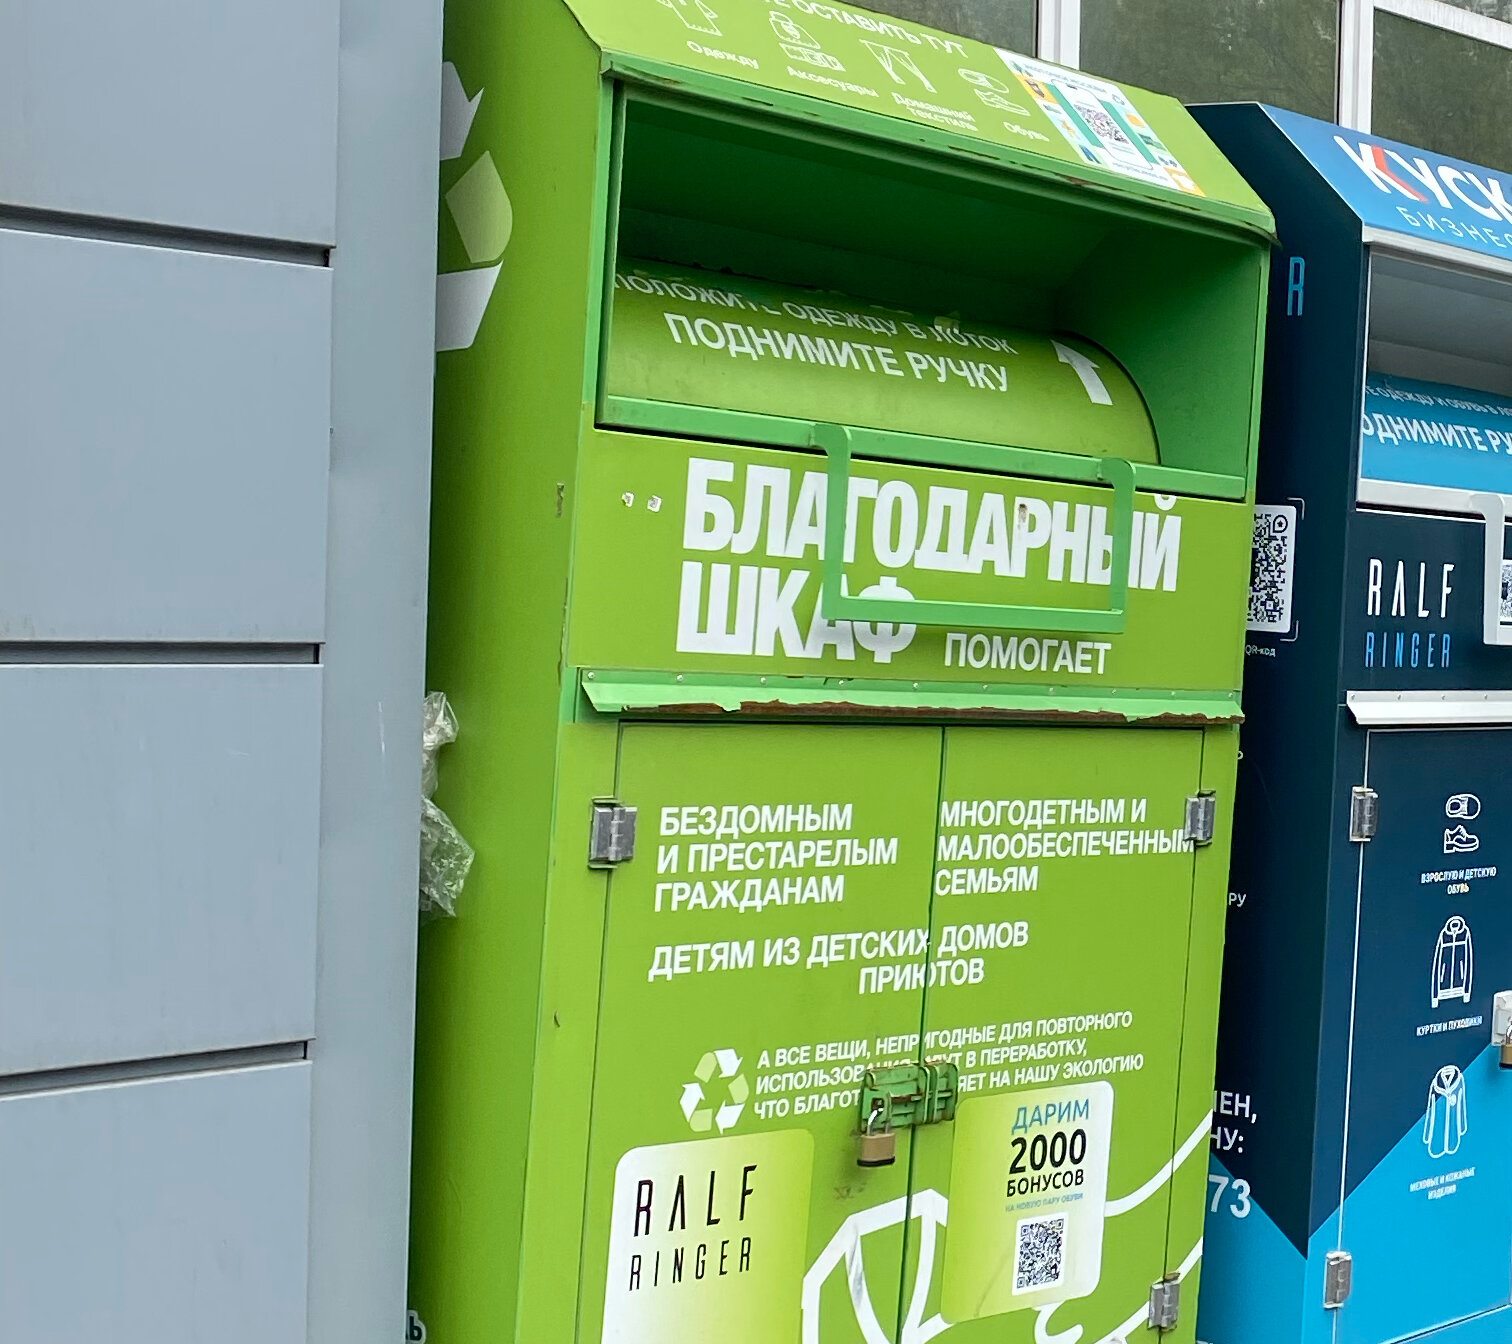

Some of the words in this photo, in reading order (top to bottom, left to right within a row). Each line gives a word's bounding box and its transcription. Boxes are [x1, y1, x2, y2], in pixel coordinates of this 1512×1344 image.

[687, 41, 759, 69] Одежду
[920, 33, 968, 58] ТУТ
[615, 274, 782, 316] ПОЛОЖИ
[782, 302, 898, 337] ОДЕЖДУ
[902, 322, 928, 339] В
[664, 312, 904, 377] ПОДНИМИТЕ
[905, 351, 1008, 392] РУЧКУ
[683, 457, 1182, 592] БЛАГОДАРНЫЙ
[1367, 558, 1455, 618] RALF
[676, 561, 917, 663] ШКАФ
[945, 633, 1112, 675] ПОМОГАЕТ
[1365, 631, 1451, 668] RINGER
[659, 803, 853, 840] БЕЗДОМНЫМ
[940, 799, 1125, 831] МНОГОДЕТНЫМ
[1130, 799, 1147, 824] И
[657, 844, 679, 874] И
[687, 837, 899, 873] ПРЕСТАРЕЛЫМ
[655, 874, 845, 913] ГРАЖДАНАМ
[935, 866, 1039, 896] СЕМЬЯМ
[648, 940, 755, 982] ДЕТЯМ
[763, 936, 800, 967] ИЗ
[806, 928, 929, 969] ДЕТСКИХ
[937, 921, 1029, 958] ДОМОВ
[859, 957, 985, 995] ПРИЮТОВ
[757, 1049, 770, 1069] А
[775, 1045, 811, 1067] ВСЕ
[815, 1039, 870, 1062] ВЕЩИ,
[998, 1020, 1033, 1044] ДЛЯ
[1036, 1010, 1133, 1037] ПОВТОРНОГО
[754, 1098, 789, 1120] ЧТО
[989, 1069, 1010, 1089] НА
[1014, 1063, 1060, 1085] НАШУ
[1063, 1053, 1144, 1079] ЭКОЛОГИЮ
[756, 1058, 911, 1094] ИСПОЛЬЗОВ
[966, 1050, 976, 1068] В
[980, 1038, 1087, 1066] ПЕРЕРАБОТКУ,
[1011, 1098, 1089, 1135] ДАРИМ
[1009, 1128, 1087, 1175] 2000
[634, 1164, 757, 1237] RALF
[1007, 1169, 1084, 1197] БОНУСОВ
[629, 1237, 751, 1291] RINGER
